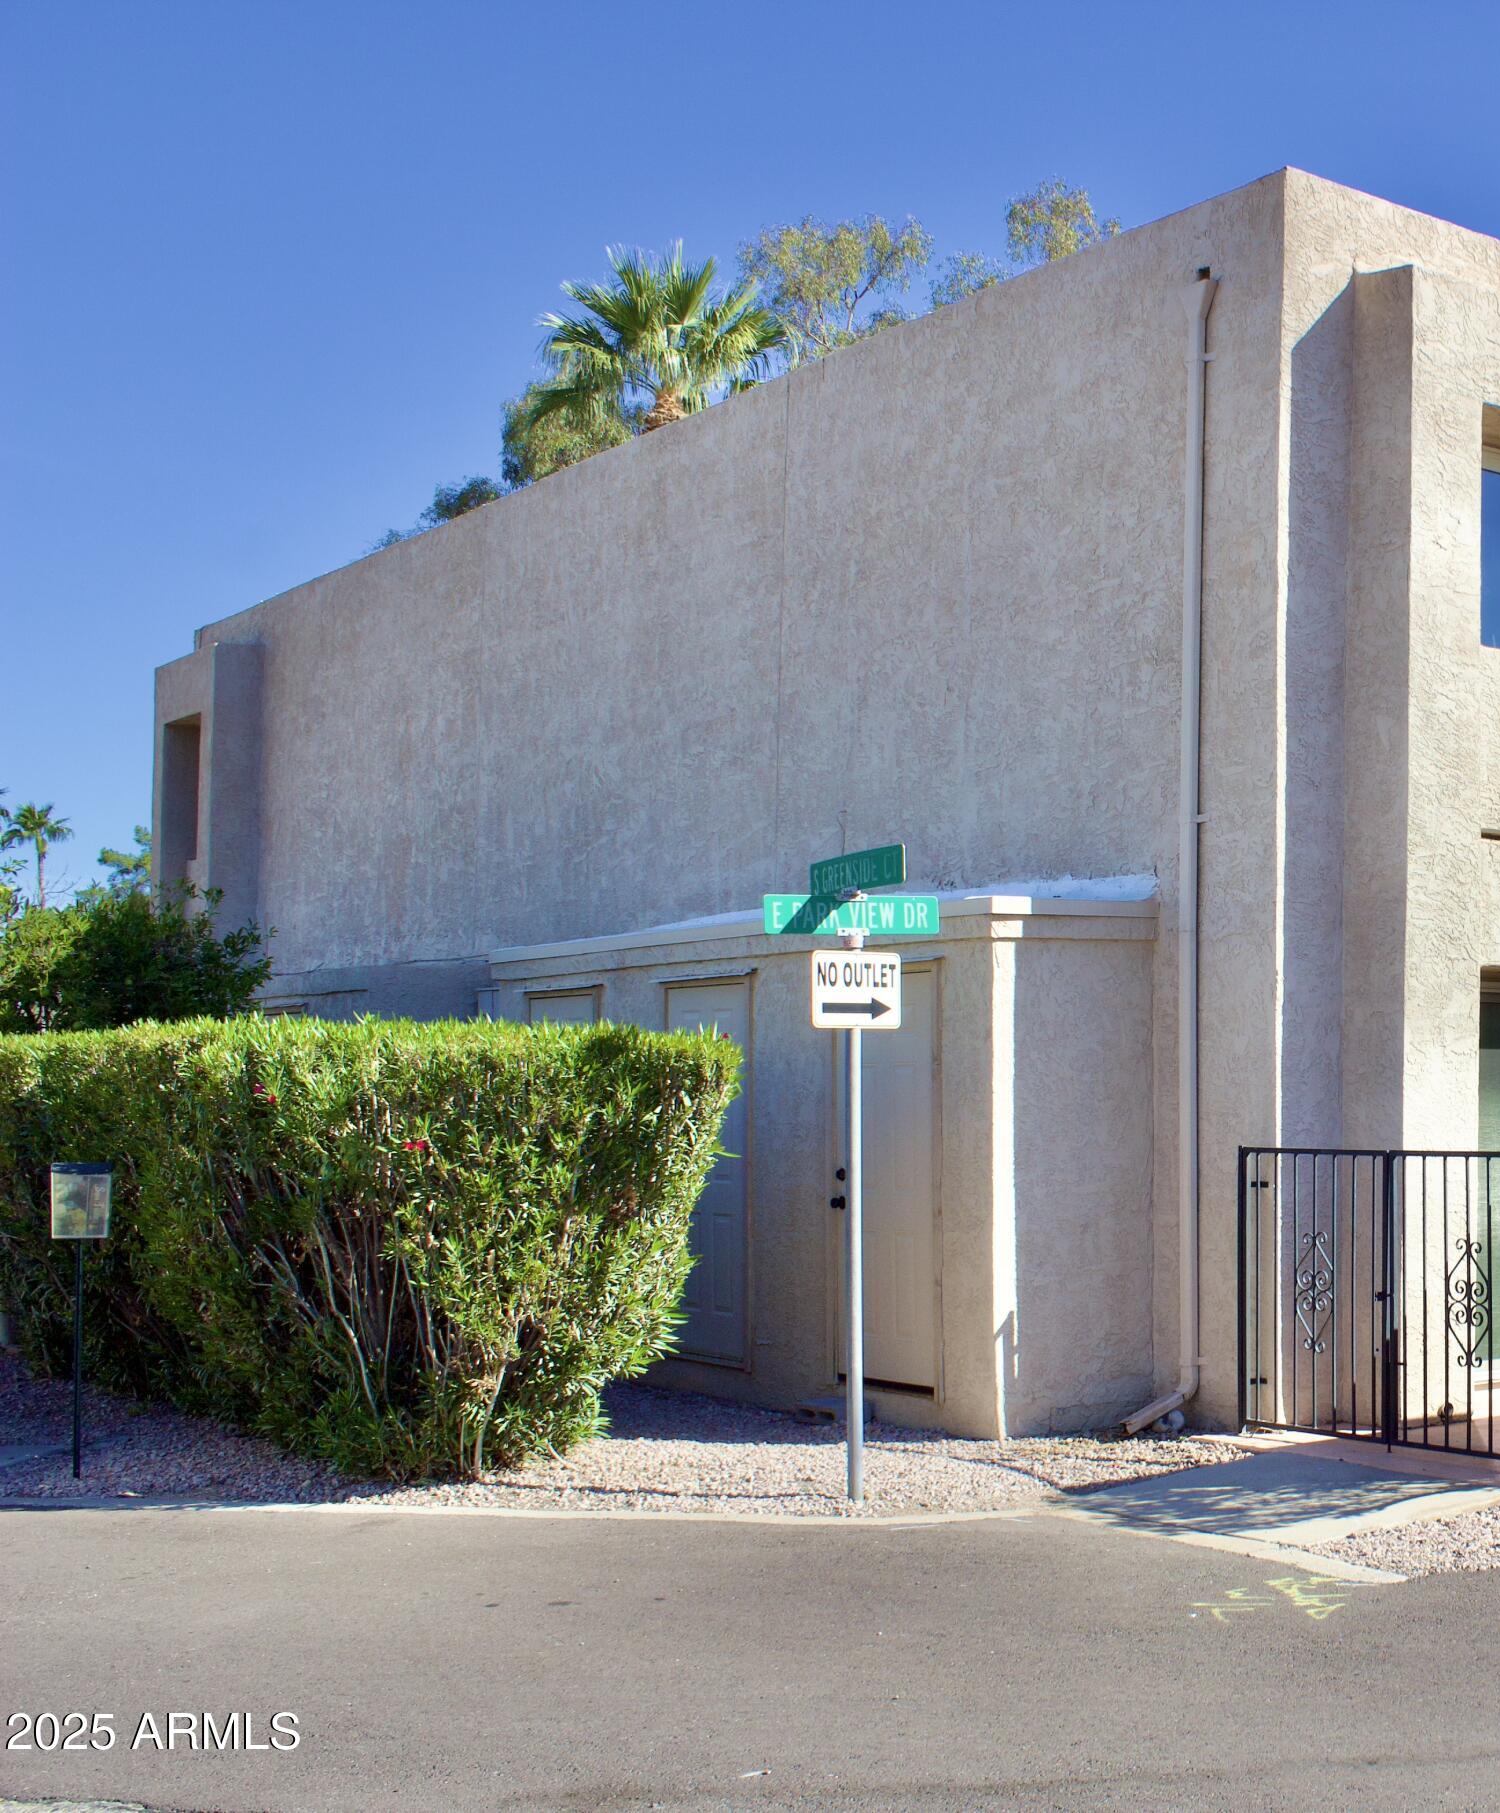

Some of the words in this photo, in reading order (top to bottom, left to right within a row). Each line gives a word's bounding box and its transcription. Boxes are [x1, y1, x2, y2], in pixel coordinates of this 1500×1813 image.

[814, 868, 820, 895] S
[822, 858, 878, 894] GREENSIDE
[883, 853, 898, 878] CT
[772, 902, 783, 928] E
[792, 902, 841, 929] PARK
[849, 902, 895, 929] VIEW
[903, 902, 928, 929] DR
[817, 962, 838, 987] NO
[843, 963, 897, 988] OUTLET
